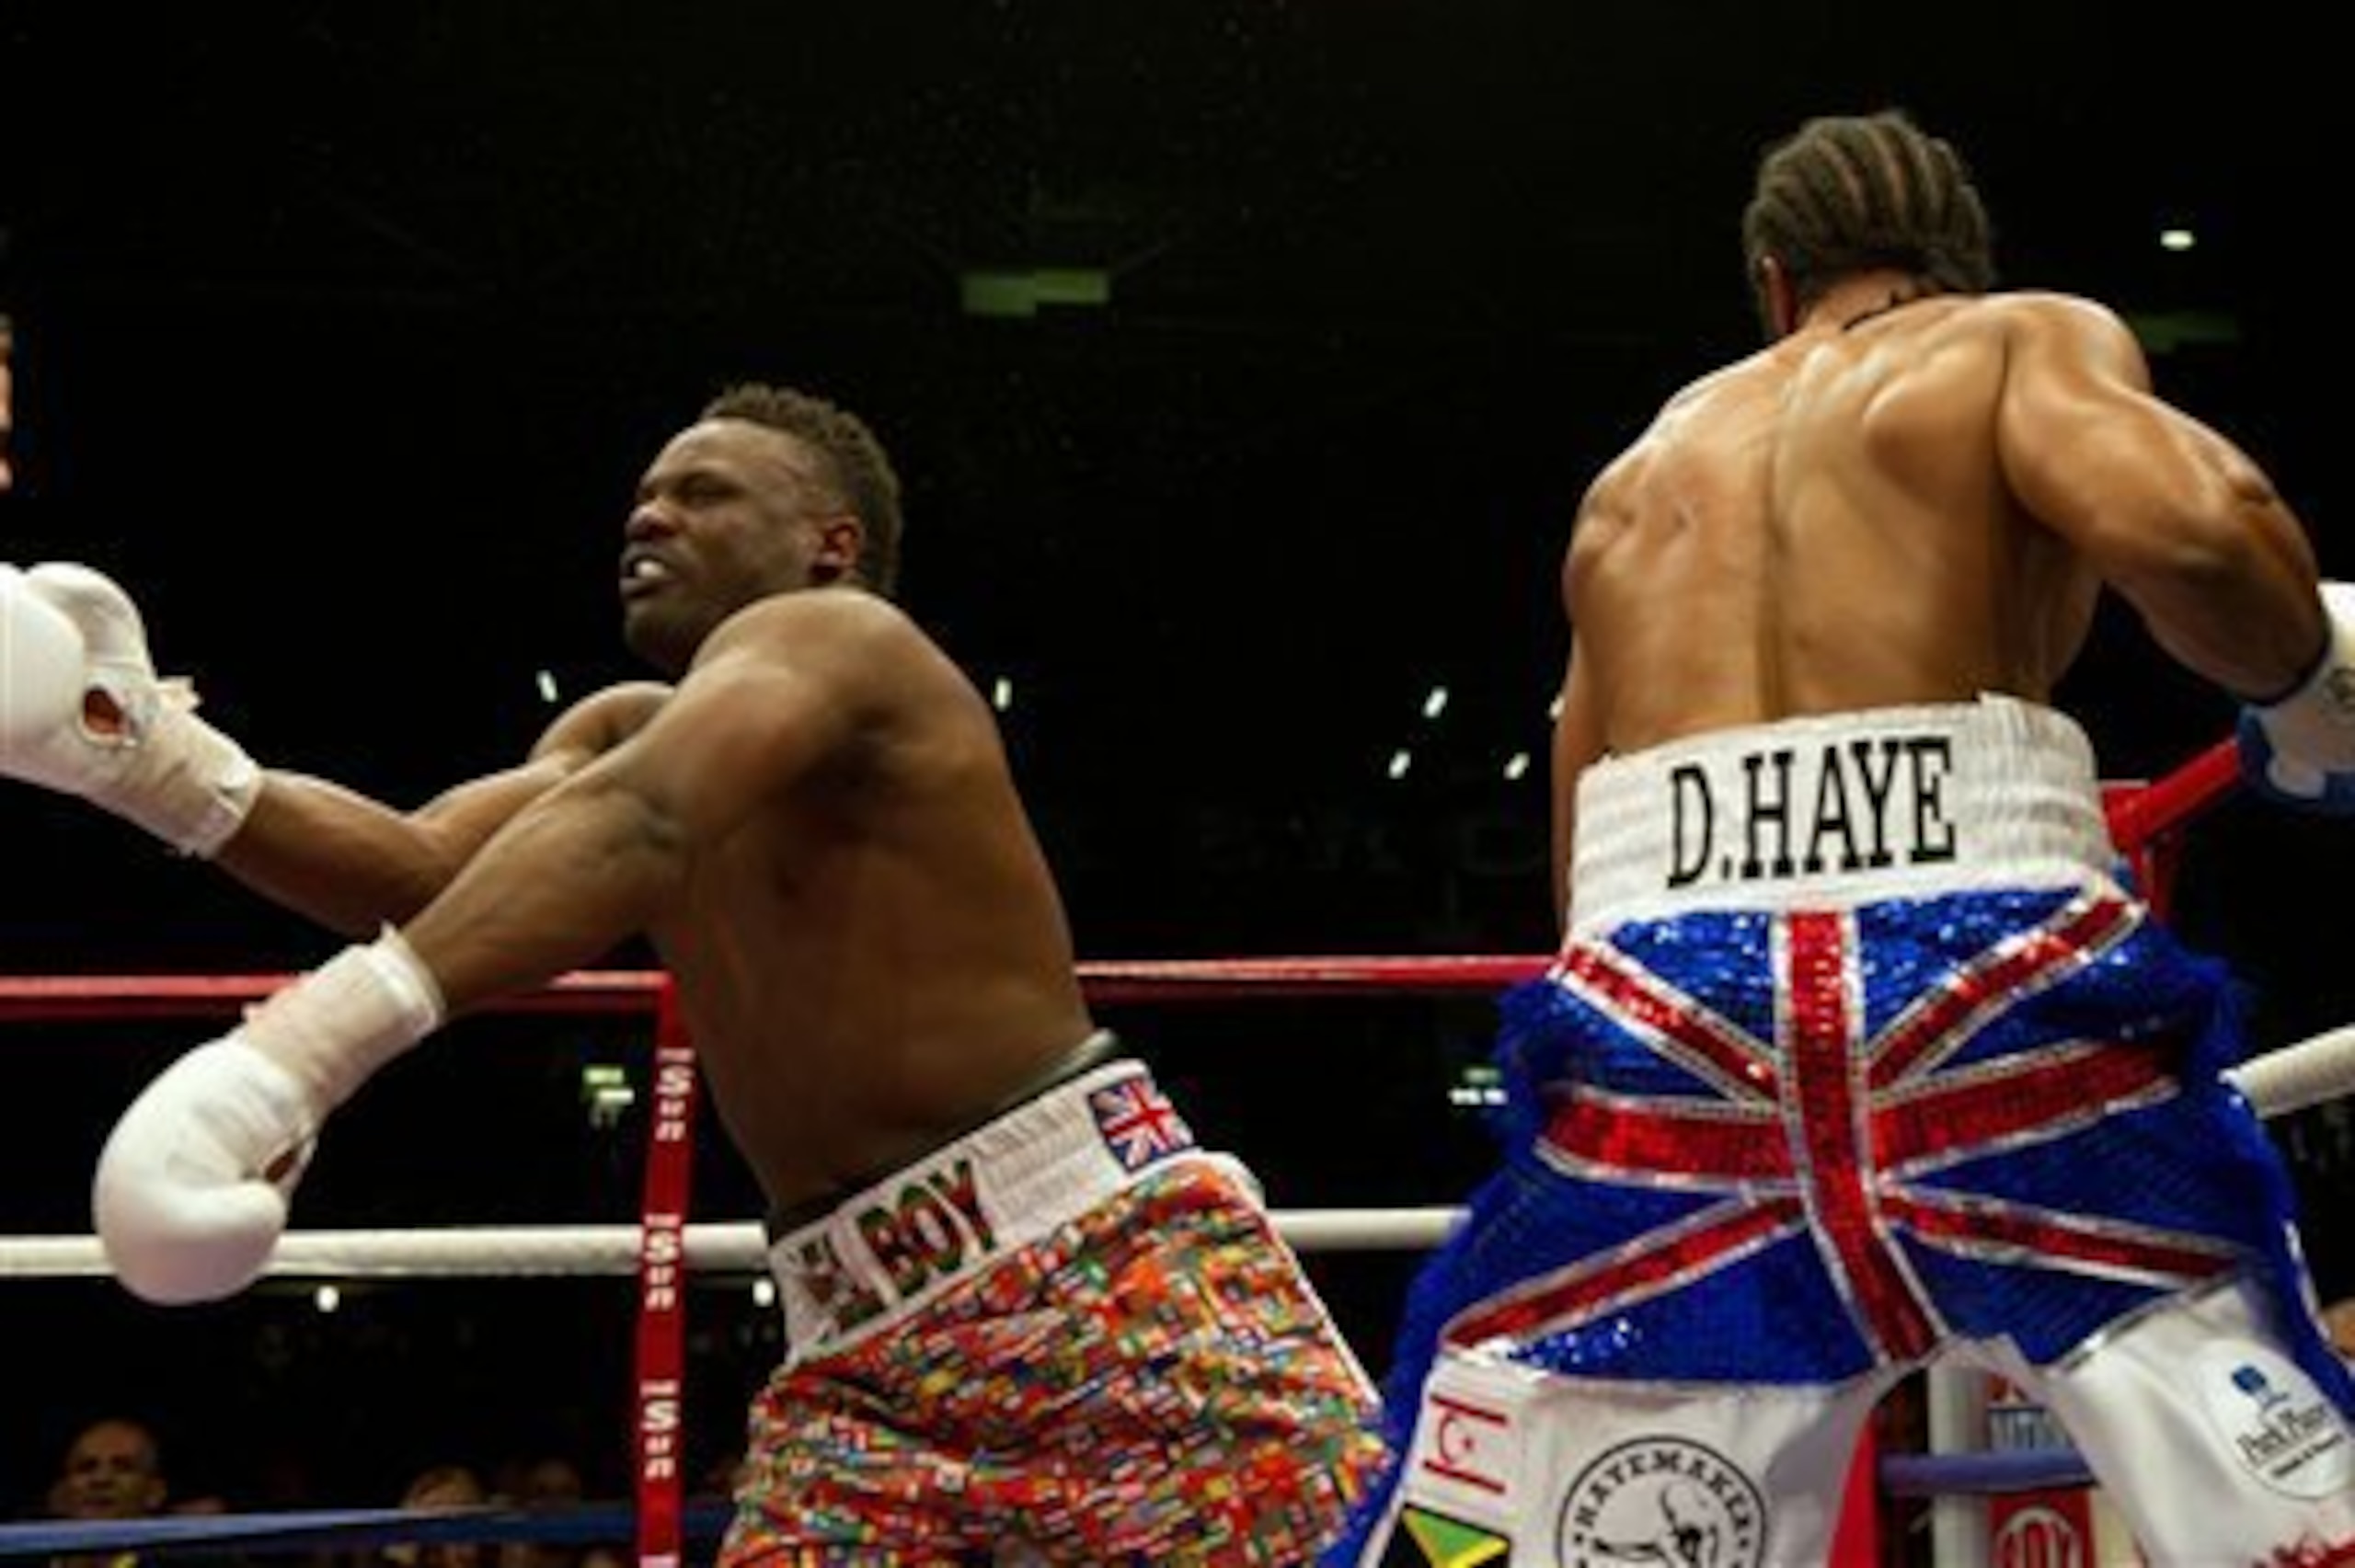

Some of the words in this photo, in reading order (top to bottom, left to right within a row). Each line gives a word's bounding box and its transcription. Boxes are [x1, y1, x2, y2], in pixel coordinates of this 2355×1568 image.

[1667, 735, 1957, 888] D.HAYE
[856, 1159, 996, 1299] BOY
[1574, 1448, 1750, 1531] HAYEMAKER
